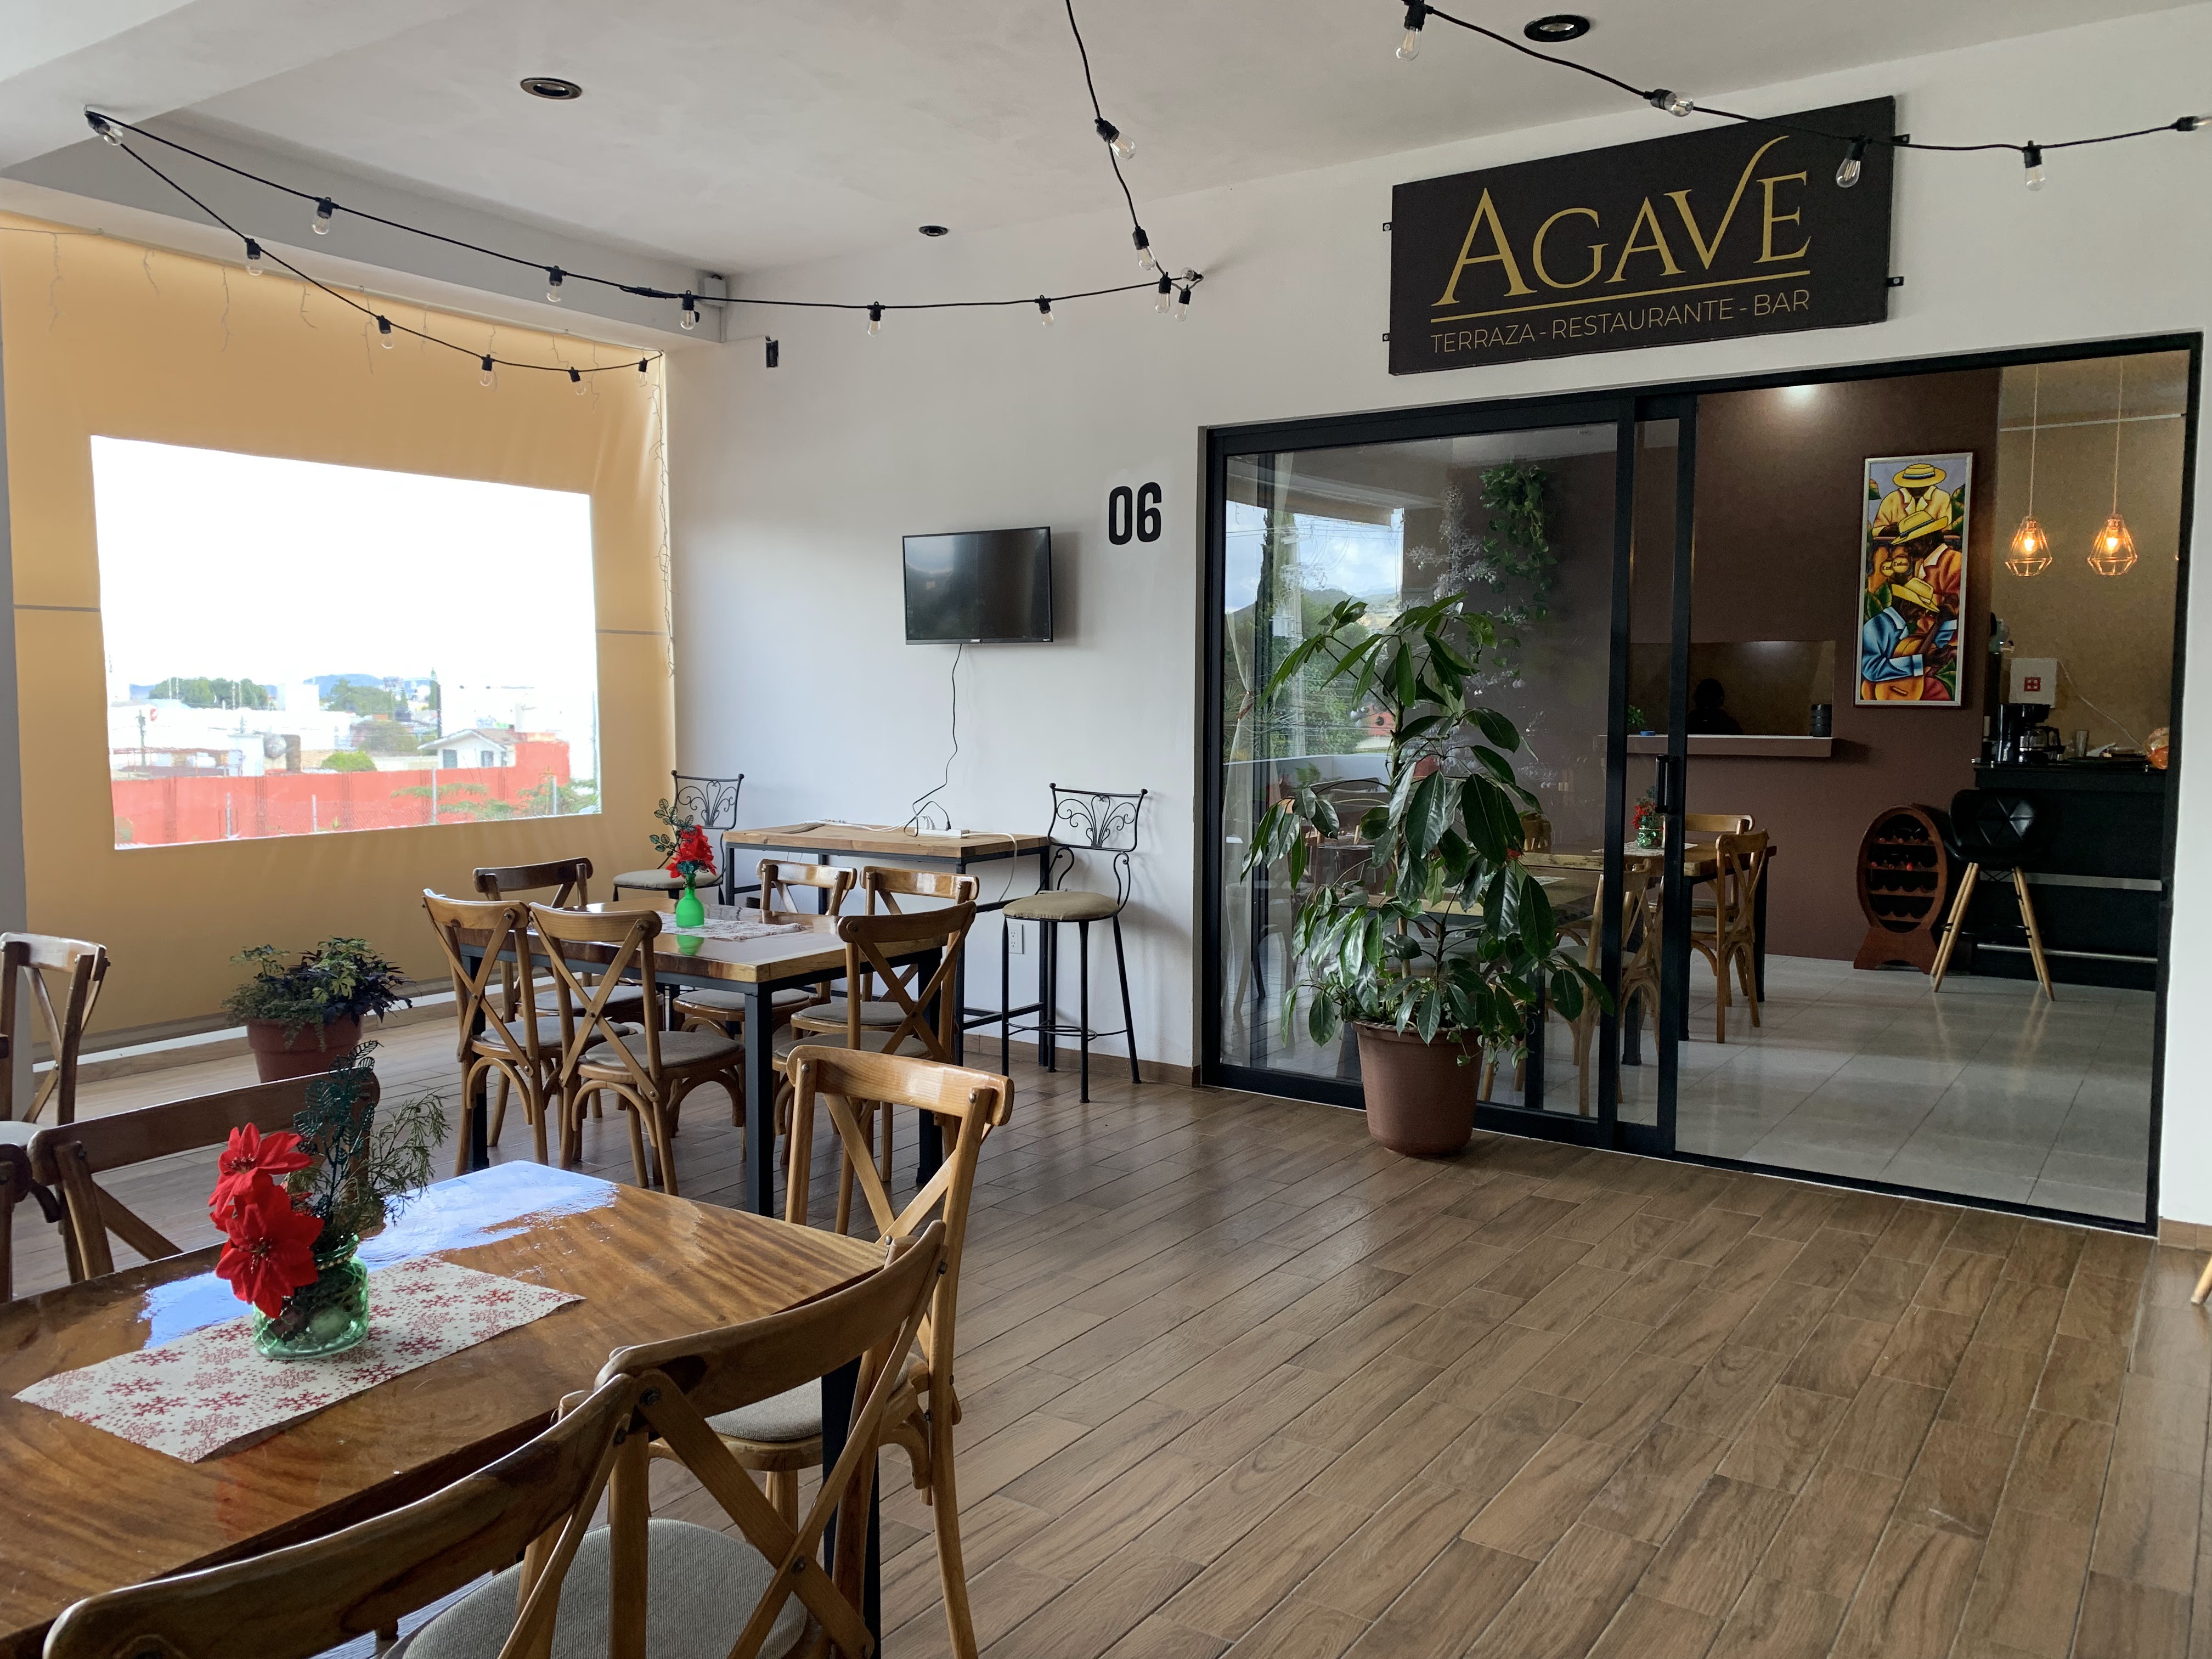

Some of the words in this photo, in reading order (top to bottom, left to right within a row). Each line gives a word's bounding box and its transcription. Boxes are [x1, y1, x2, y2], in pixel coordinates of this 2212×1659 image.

[1431, 135, 1812, 307] AGAVE
[1430, 323, 1535, 353] TERRAZA
[1552, 298, 1734, 339] RESTAURANTE
[1754, 289, 1809, 316] BAR
[1108, 482, 1162, 545] 06
